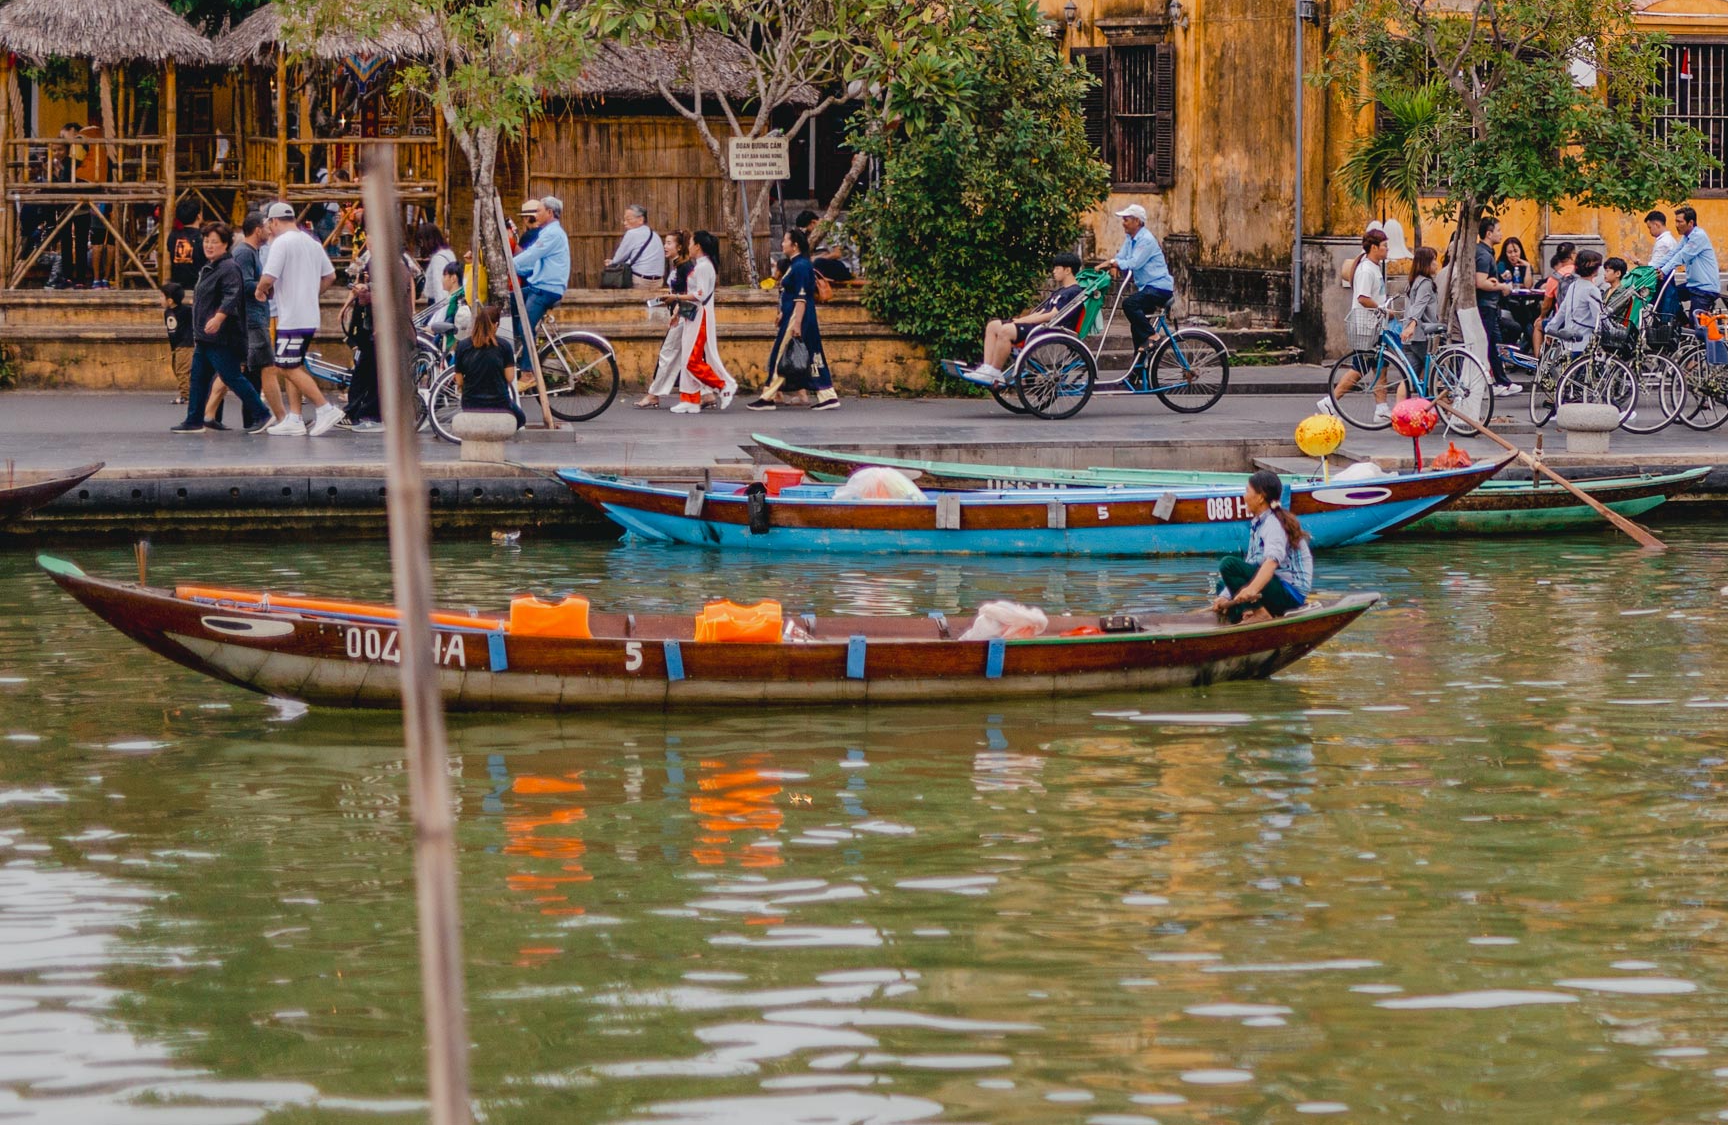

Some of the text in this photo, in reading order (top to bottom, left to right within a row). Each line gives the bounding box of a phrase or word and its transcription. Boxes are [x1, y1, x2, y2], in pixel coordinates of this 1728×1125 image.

[1097, 506, 1109, 520] 5
[1206, 497, 1234, 521] 088
[346, 627, 400, 663] 004
[625, 641, 643, 671] 5
